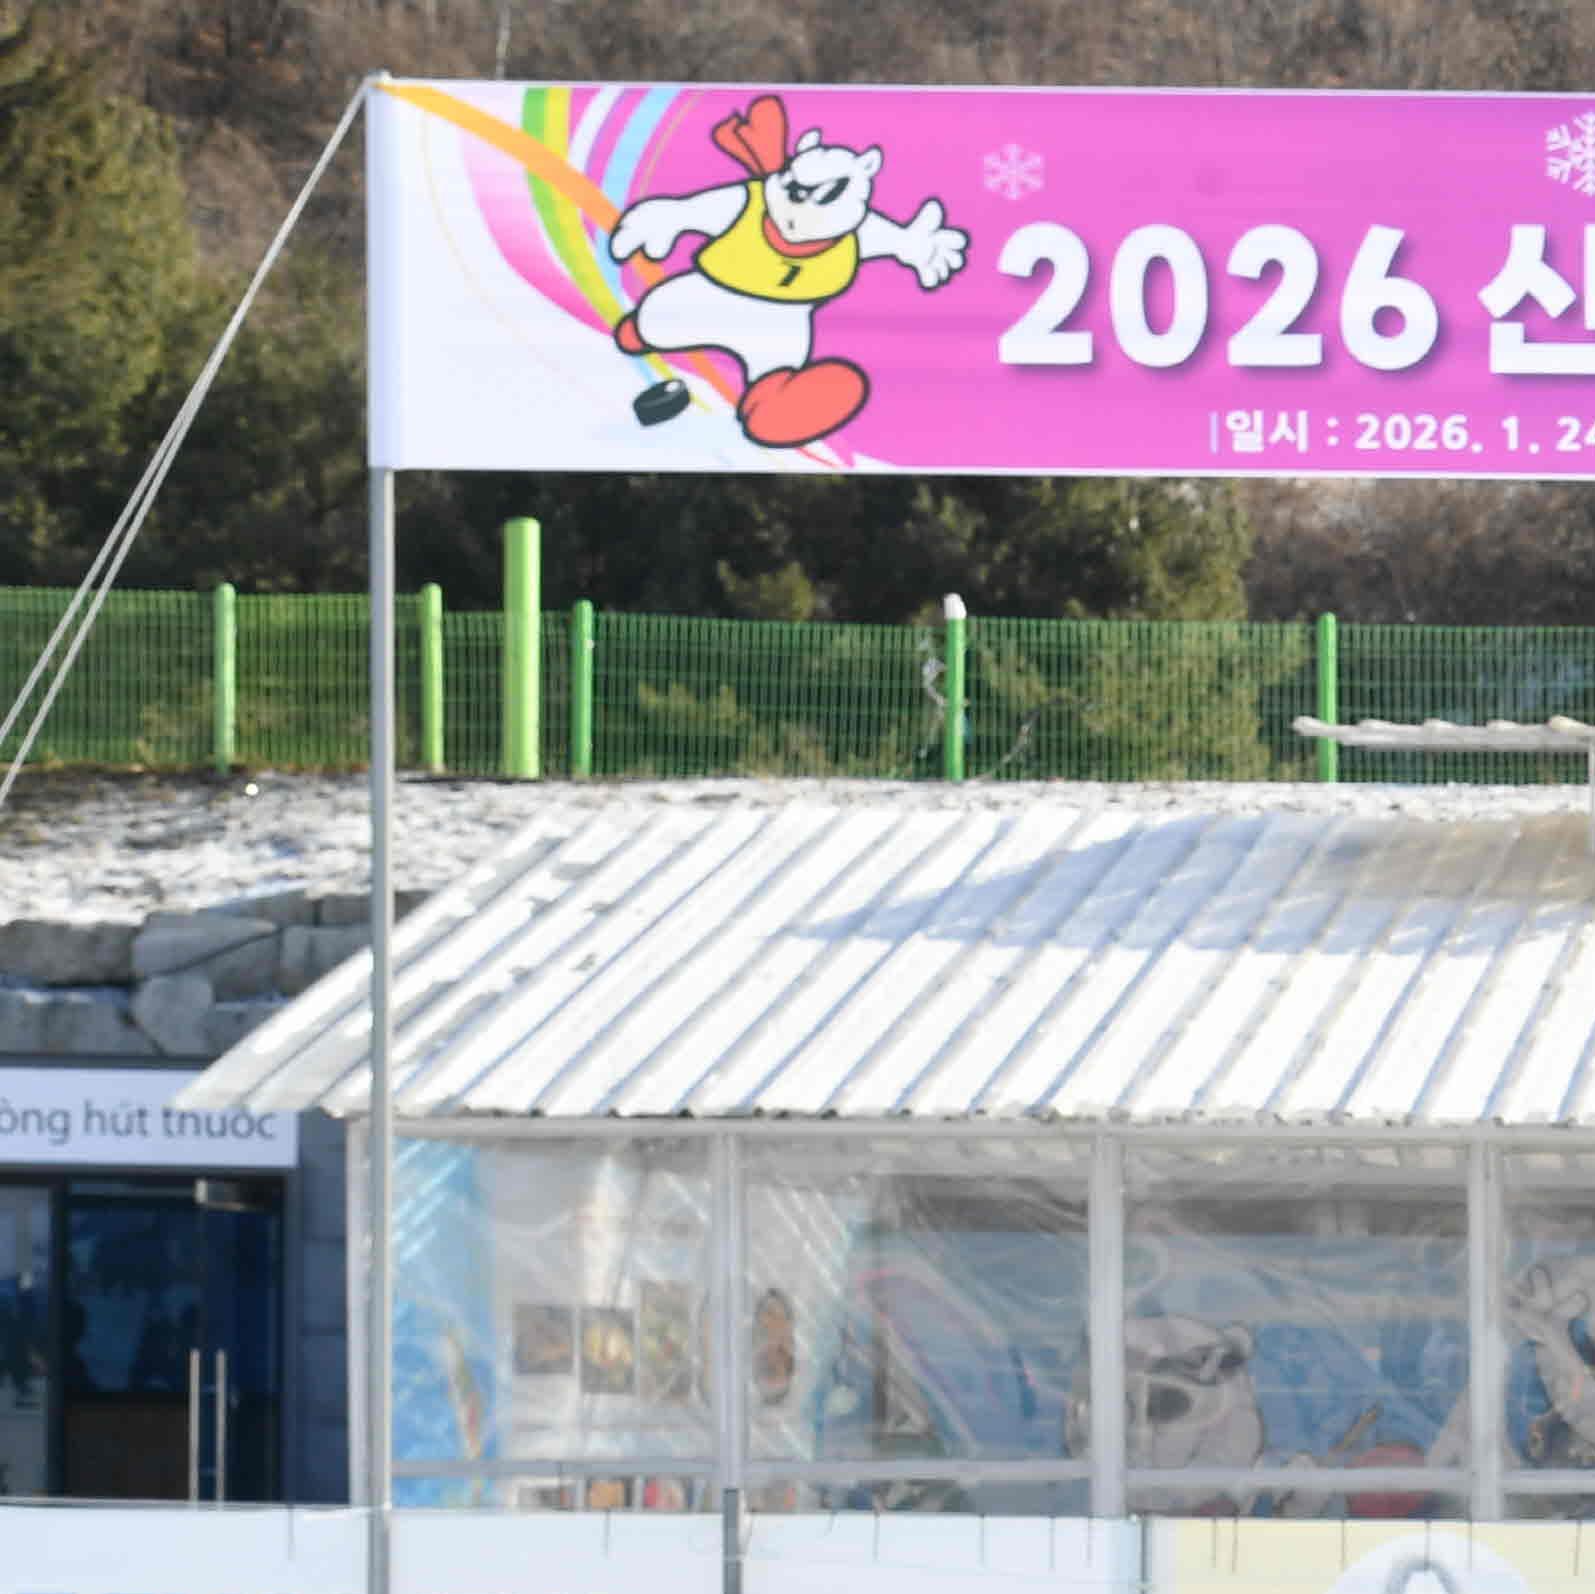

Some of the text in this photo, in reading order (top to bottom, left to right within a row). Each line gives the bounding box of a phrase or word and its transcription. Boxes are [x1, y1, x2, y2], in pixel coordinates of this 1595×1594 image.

[997, 220, 1440, 371] 2026
[1224, 409, 1310, 455] 일시
[1353, 412, 1484, 454] 2026.
[1501, 414, 1541, 456] 1.
